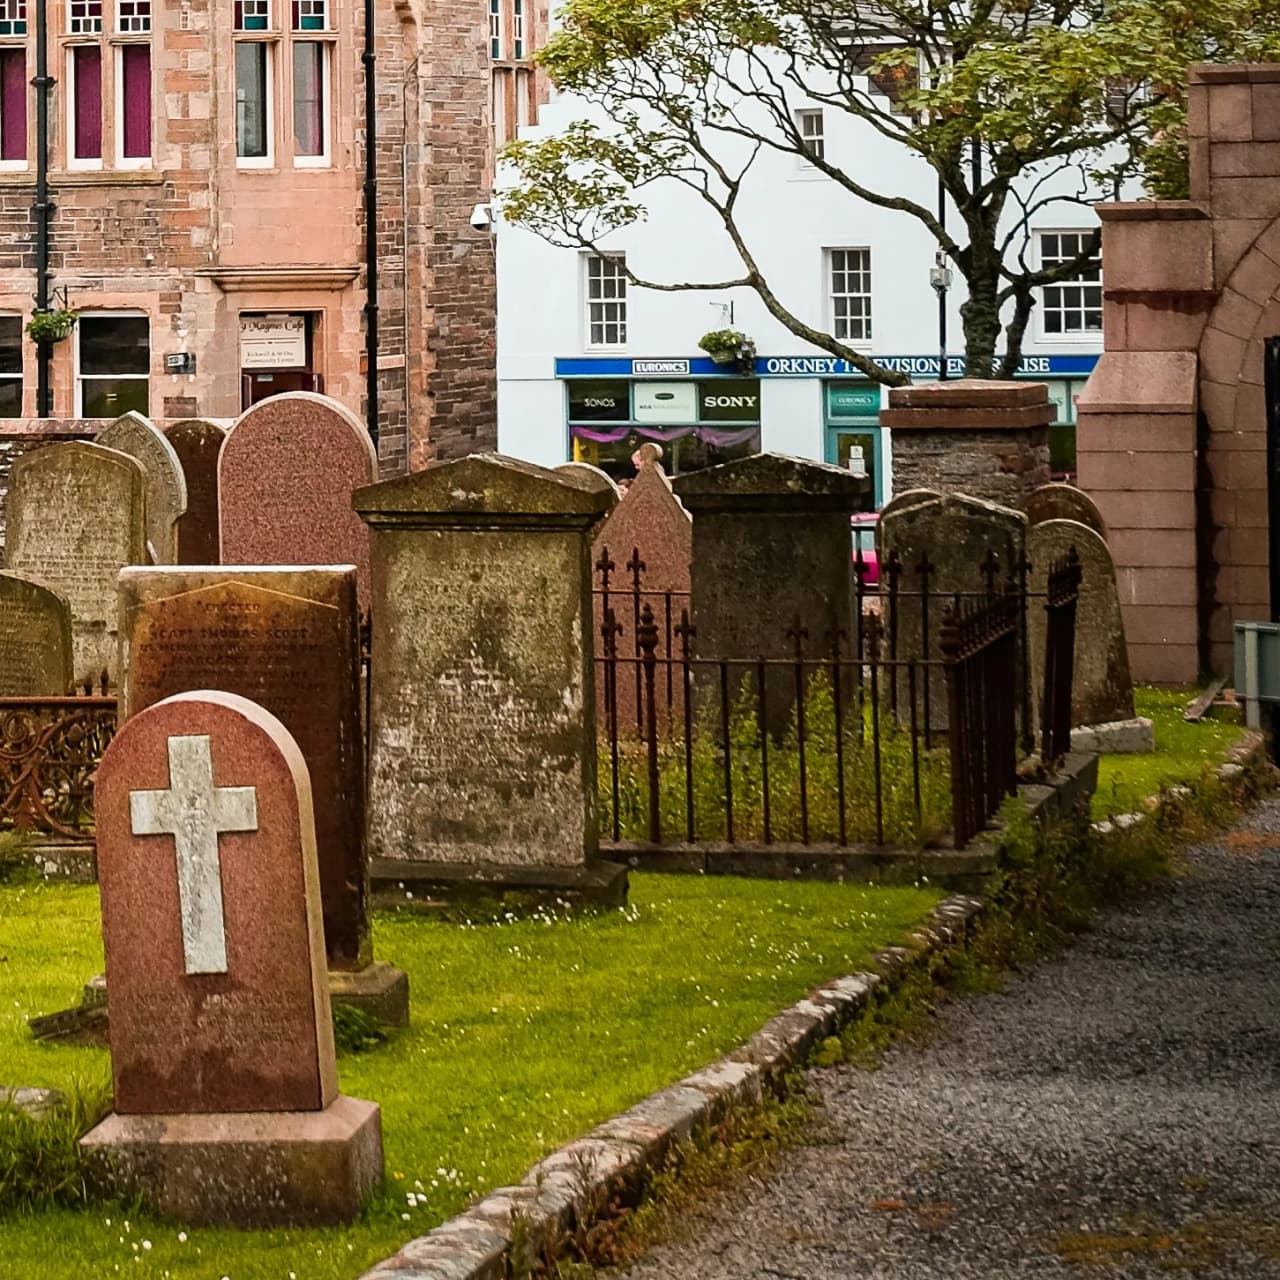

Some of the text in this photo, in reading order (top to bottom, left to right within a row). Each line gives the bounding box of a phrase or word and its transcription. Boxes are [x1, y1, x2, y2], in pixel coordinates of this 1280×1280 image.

[636, 362, 687, 373] EURONICS
[767, 357, 1051, 373] ORKNEY TEVISION ENRISE
[583, 398, 615, 408] SONOS
[704, 396, 757, 408] SONY
